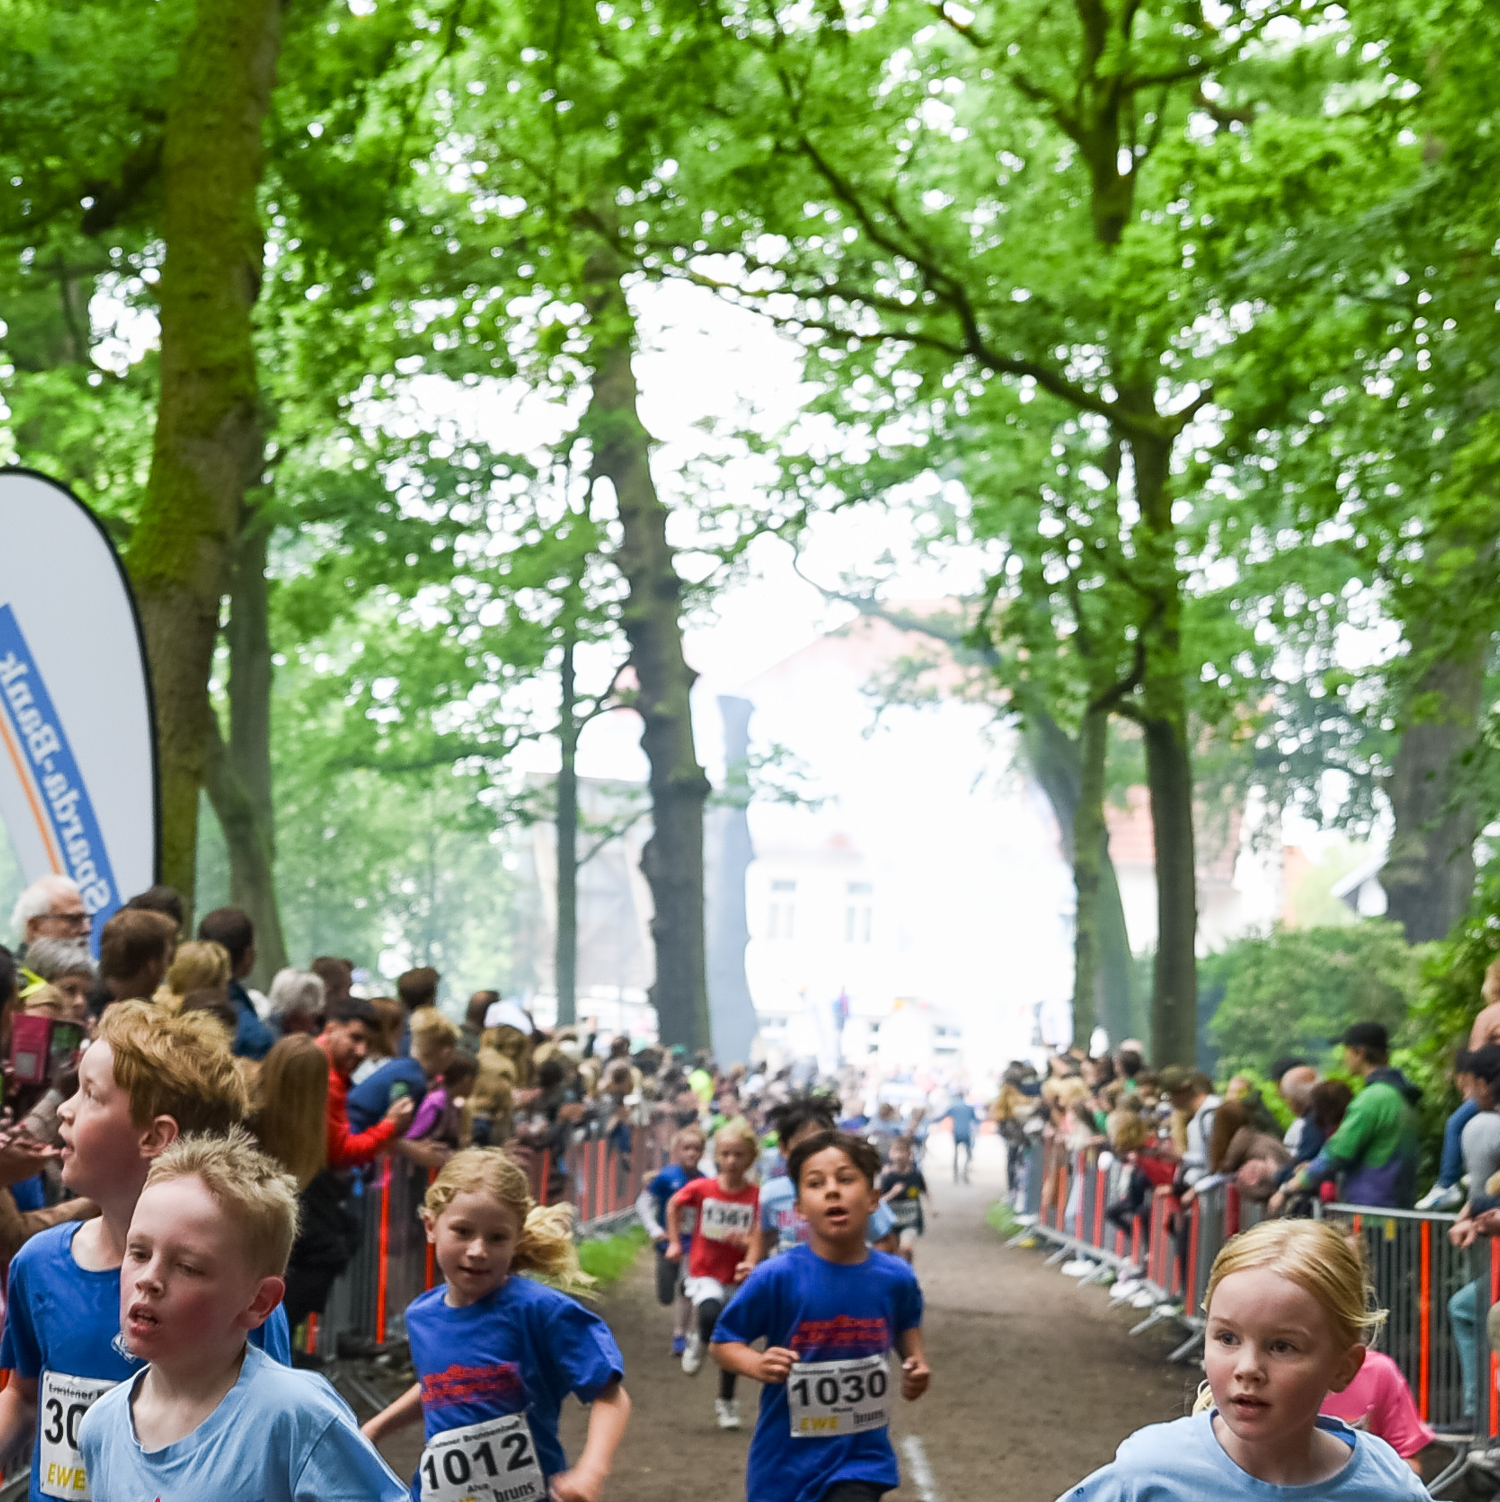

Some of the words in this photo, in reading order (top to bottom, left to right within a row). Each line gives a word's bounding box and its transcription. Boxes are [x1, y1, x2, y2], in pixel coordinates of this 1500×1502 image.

[791, 1370, 886, 1407] 1030
[47, 1463, 86, 1490] EWE
[423, 1432, 534, 1490] 1012
[493, 1481, 535, 1502] bruns
